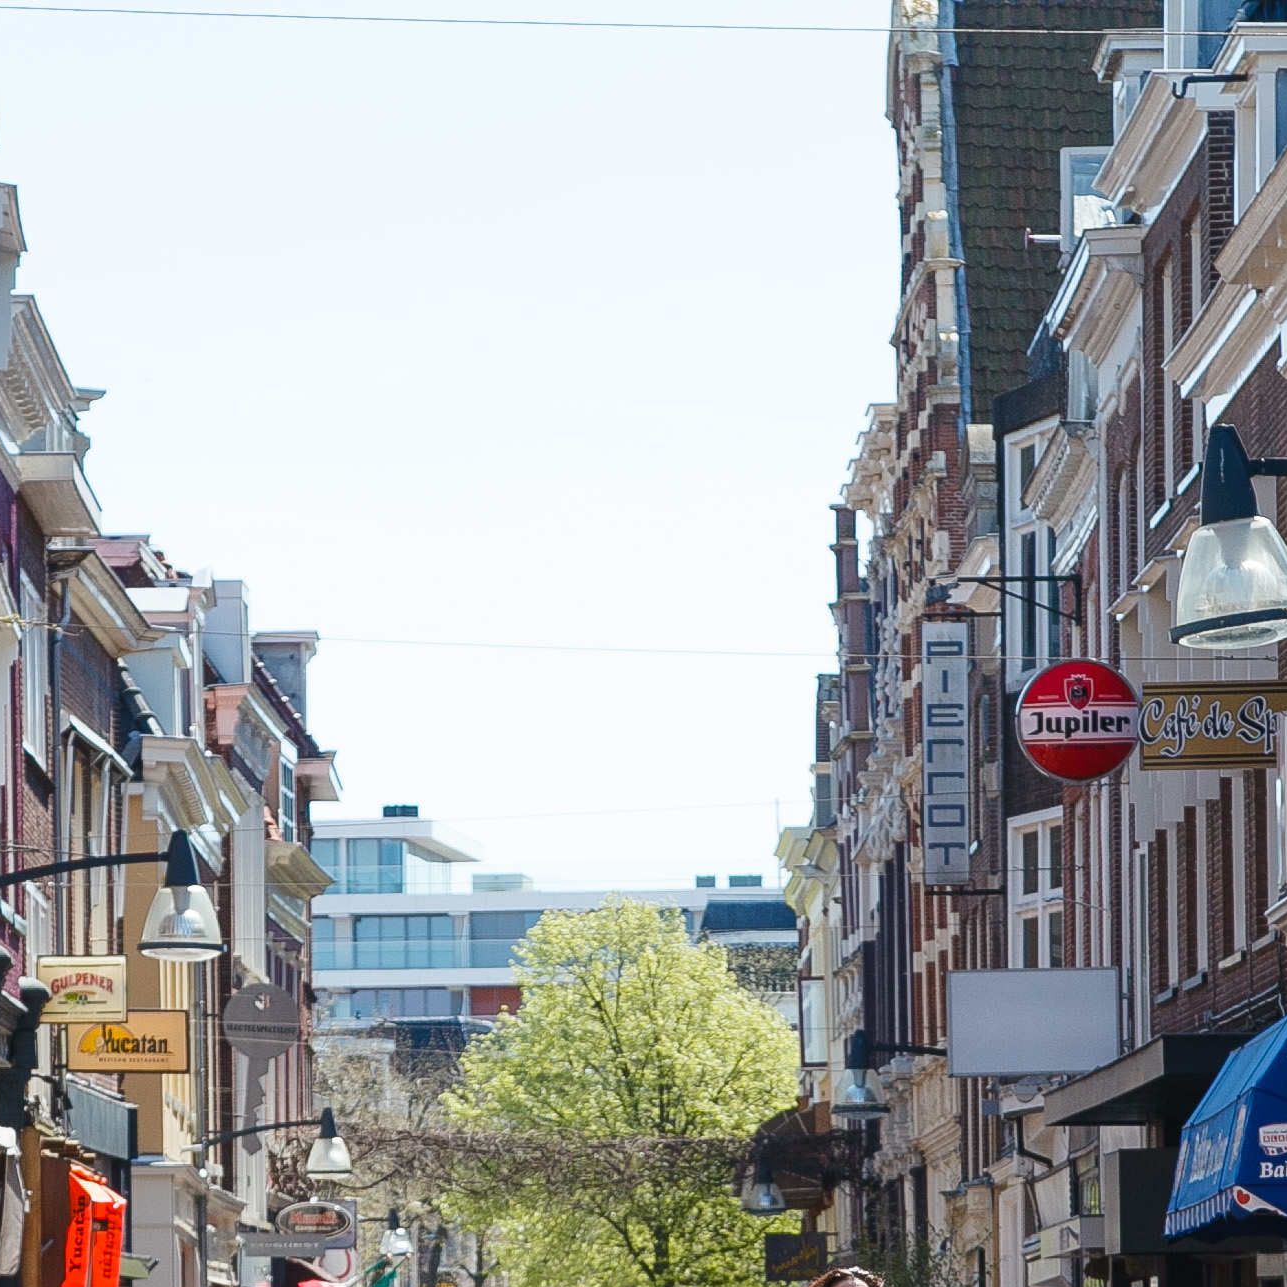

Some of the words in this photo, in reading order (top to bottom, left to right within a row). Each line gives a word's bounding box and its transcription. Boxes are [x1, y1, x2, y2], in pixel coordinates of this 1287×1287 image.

[1026, 709, 1131, 742] Jupiler
[1201, 700, 1236, 740] de
[50, 972, 113, 995] GULPENER
[69, 1194, 87, 1273] Yucatán
